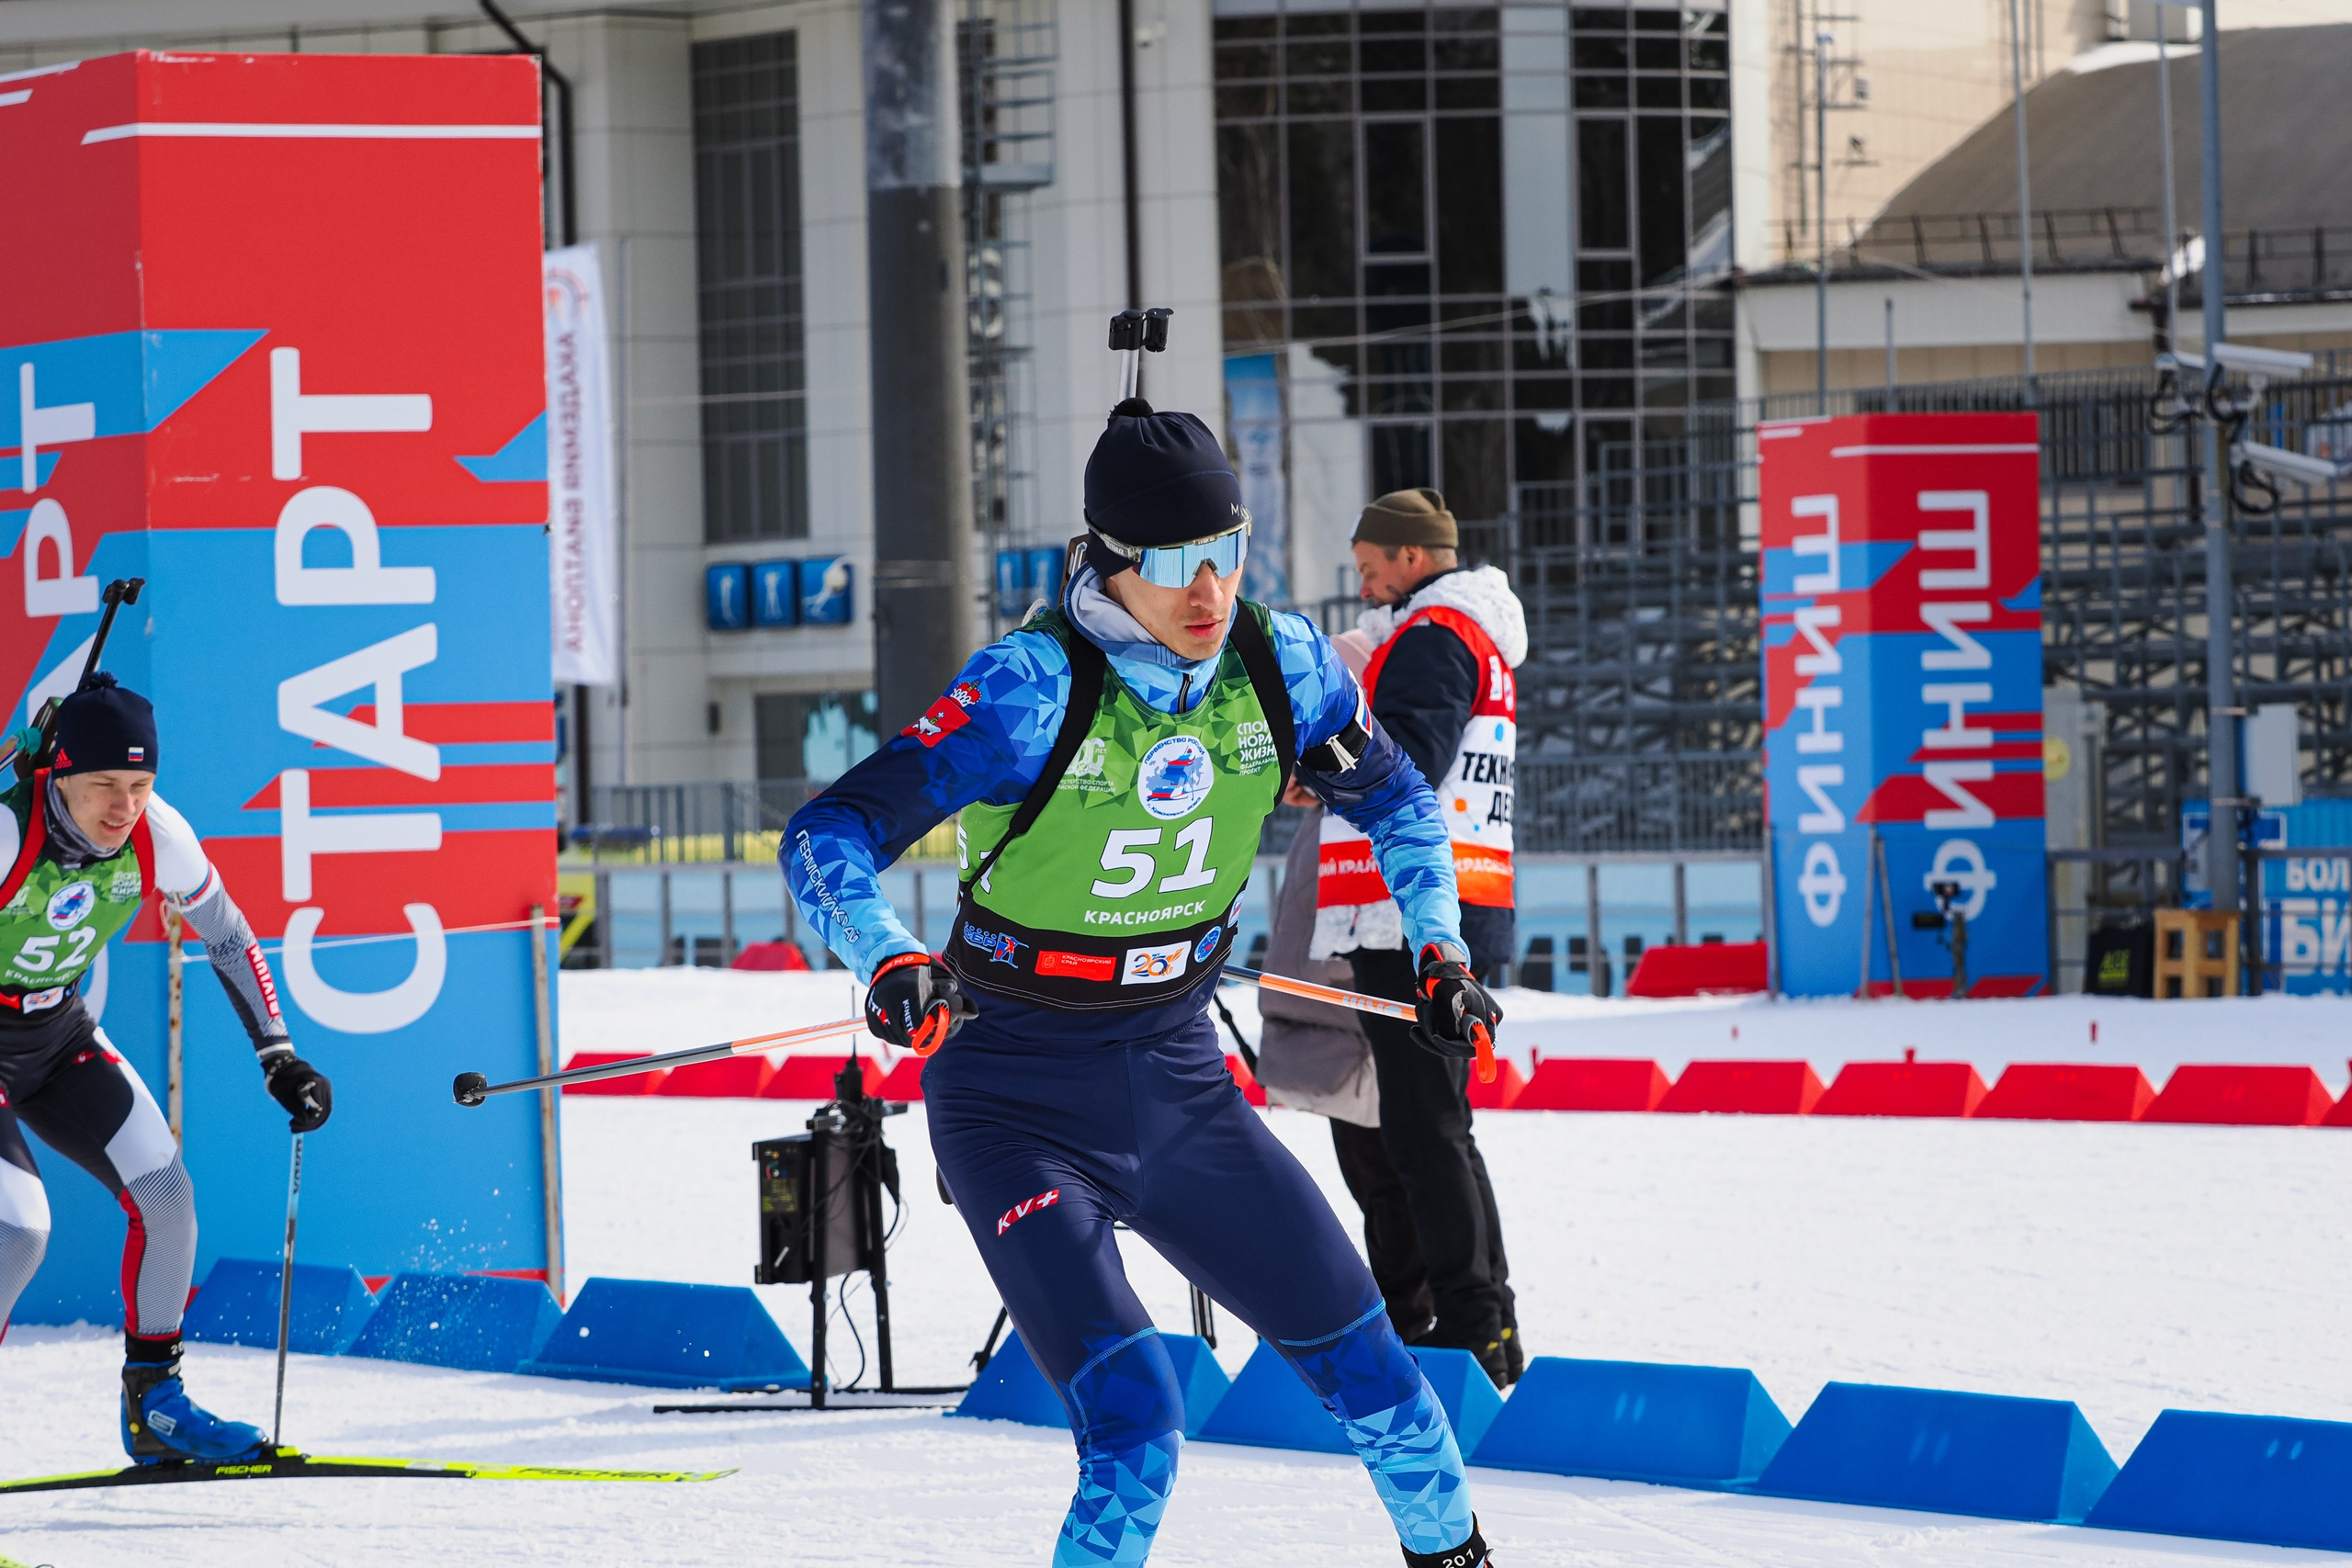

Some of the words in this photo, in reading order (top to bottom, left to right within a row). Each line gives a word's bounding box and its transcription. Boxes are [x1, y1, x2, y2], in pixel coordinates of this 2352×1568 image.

[270, 346, 447, 1034] СТАРТ
[1791, 493, 1847, 927] ФИНИШ
[1917, 490, 1996, 922] ФИНИШ
[1144, 737, 1187, 764] ПЕРВЕНСТВО
[796, 829, 838, 910] ПЕРМСКИЙ
[1089, 815, 1218, 899] 51
[1083, 900, 1207, 926] КРАСНОЯРСК
[12, 925, 97, 973] 52
[1061, 954, 1112, 965] КРАСНОЯРСКИЙ
[215, 1465, 273, 1475] FISCHER
